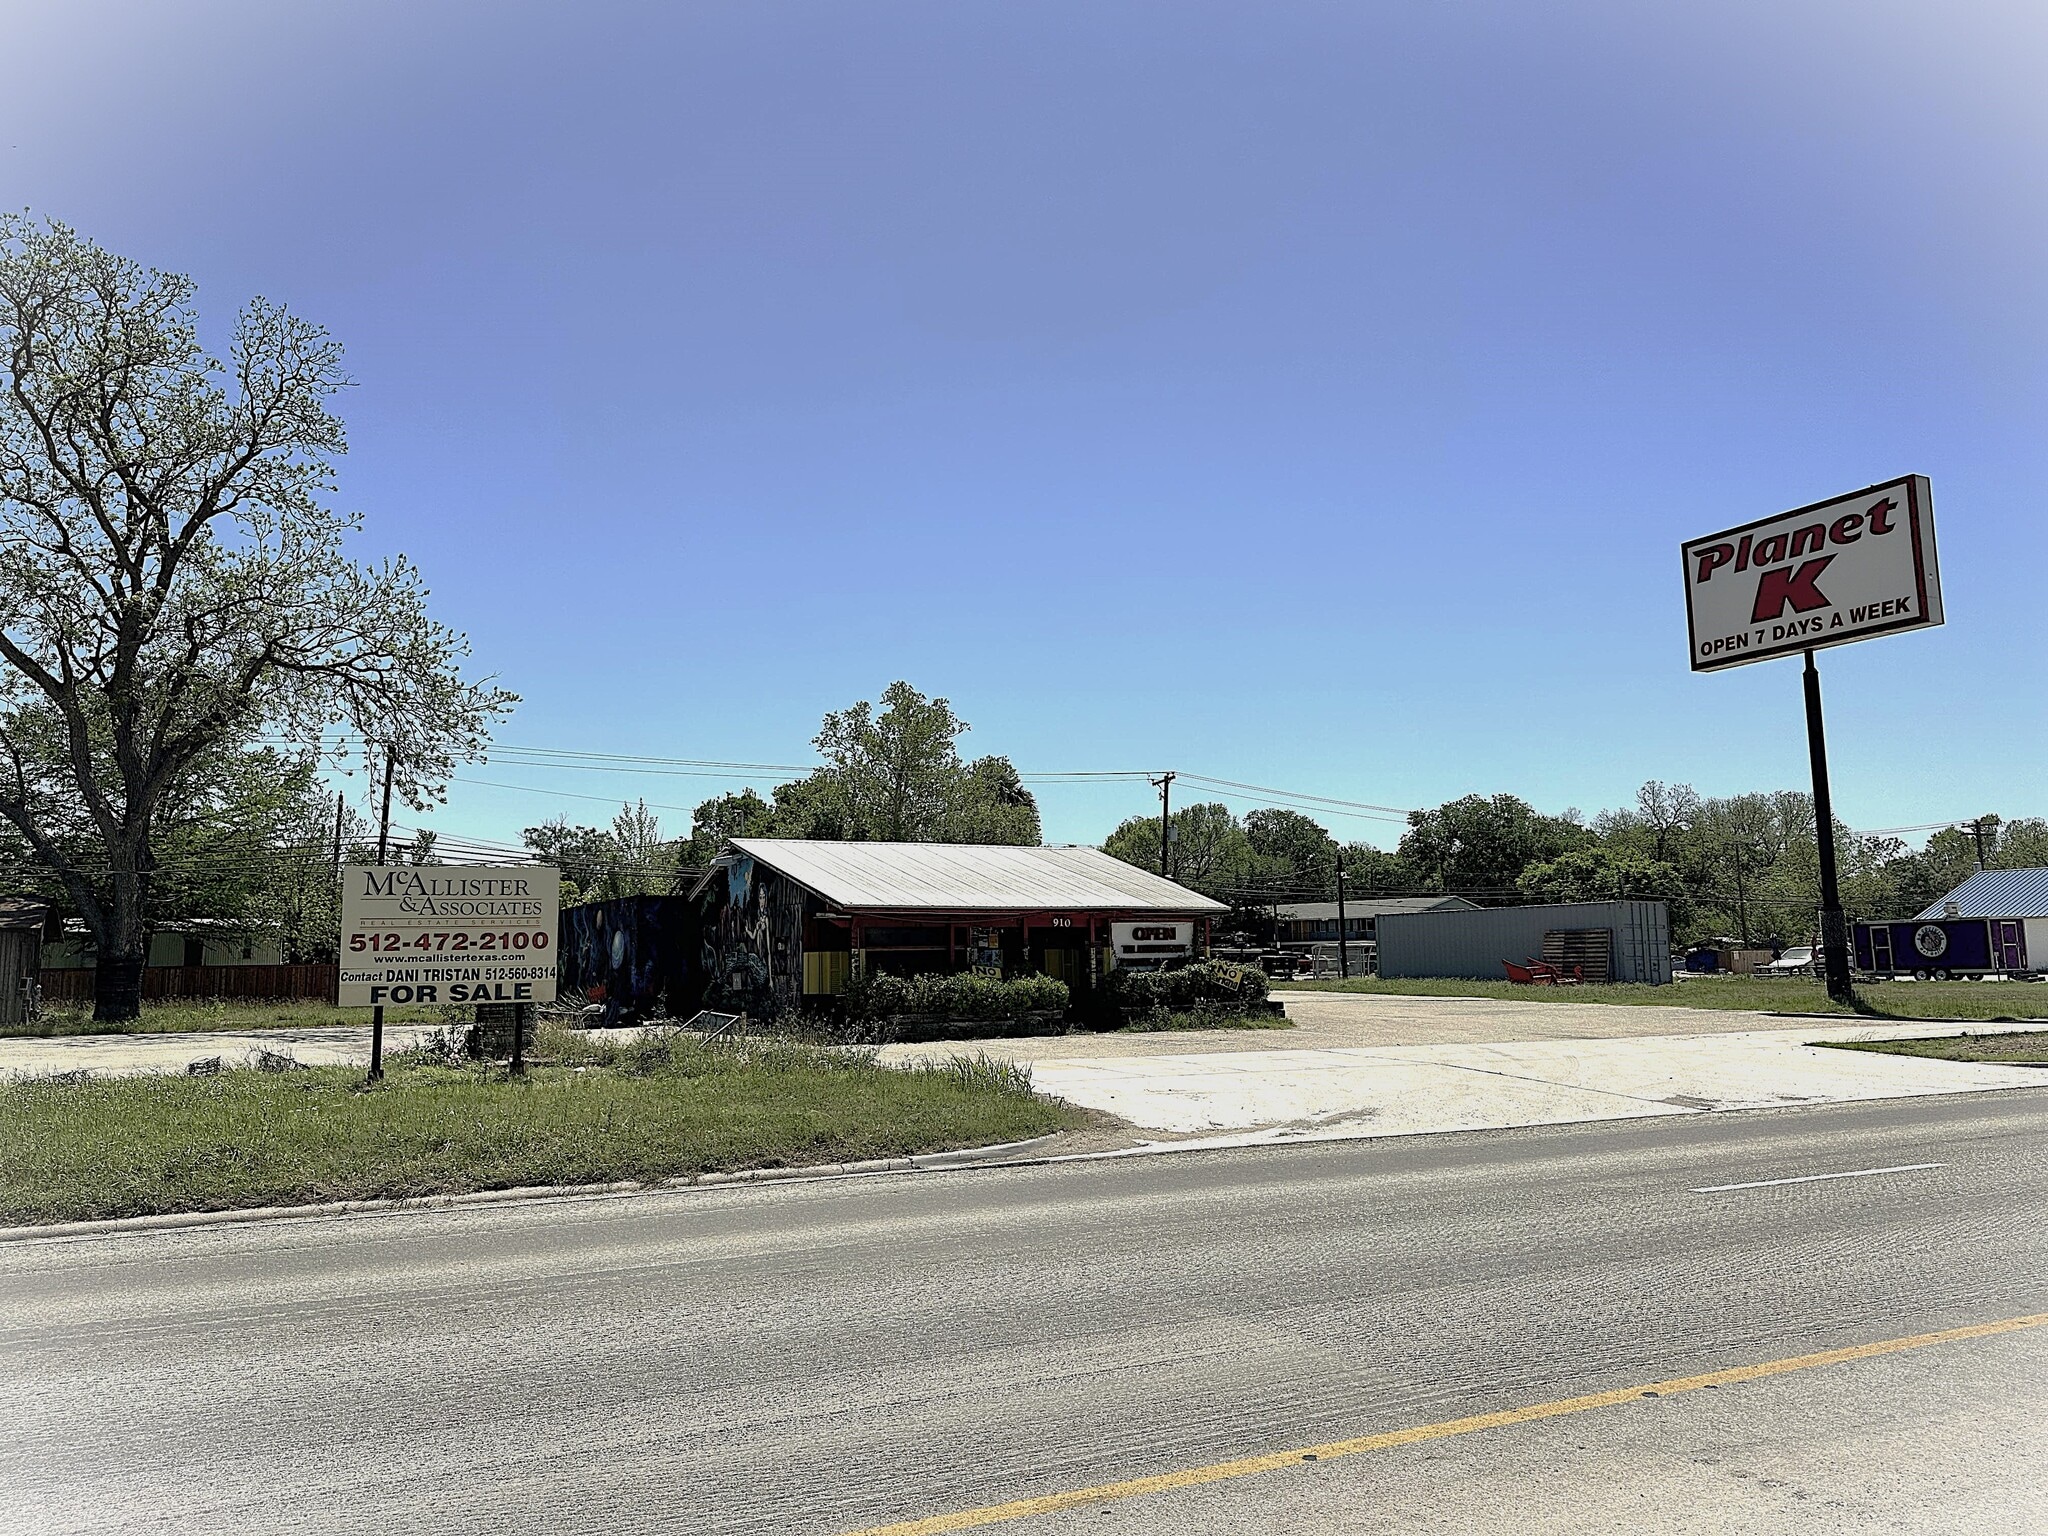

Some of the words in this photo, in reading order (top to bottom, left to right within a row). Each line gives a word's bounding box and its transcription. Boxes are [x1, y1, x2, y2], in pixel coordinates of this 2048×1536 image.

[1692, 496, 1899, 584] Planet
[1750, 552, 1838, 624] K
[1700, 632, 1749, 656] OPEN
[1755, 629, 1765, 644] 7
[1772, 616, 1823, 641] DAYS
[1829, 611, 1843, 629] A
[1849, 595, 1911, 624] WEEK
[1052, 918, 1071, 928] 910
[349, 931, 549, 952] 512-472-2100
[1132, 927, 1177, 941] OPEN
[373, 953, 526, 963] www.mcallistertexas.com
[340, 970, 383, 982] Contact
[386, 969, 419, 983] DANI
[423, 968, 480, 981] TRISTAN
[484, 966, 556, 980] 512-560-8314
[975, 966, 997, 977] NO
[1217, 963, 1237, 979] NO
[370, 984, 438, 1004] FOR
[449, 983, 532, 1002] SALE
